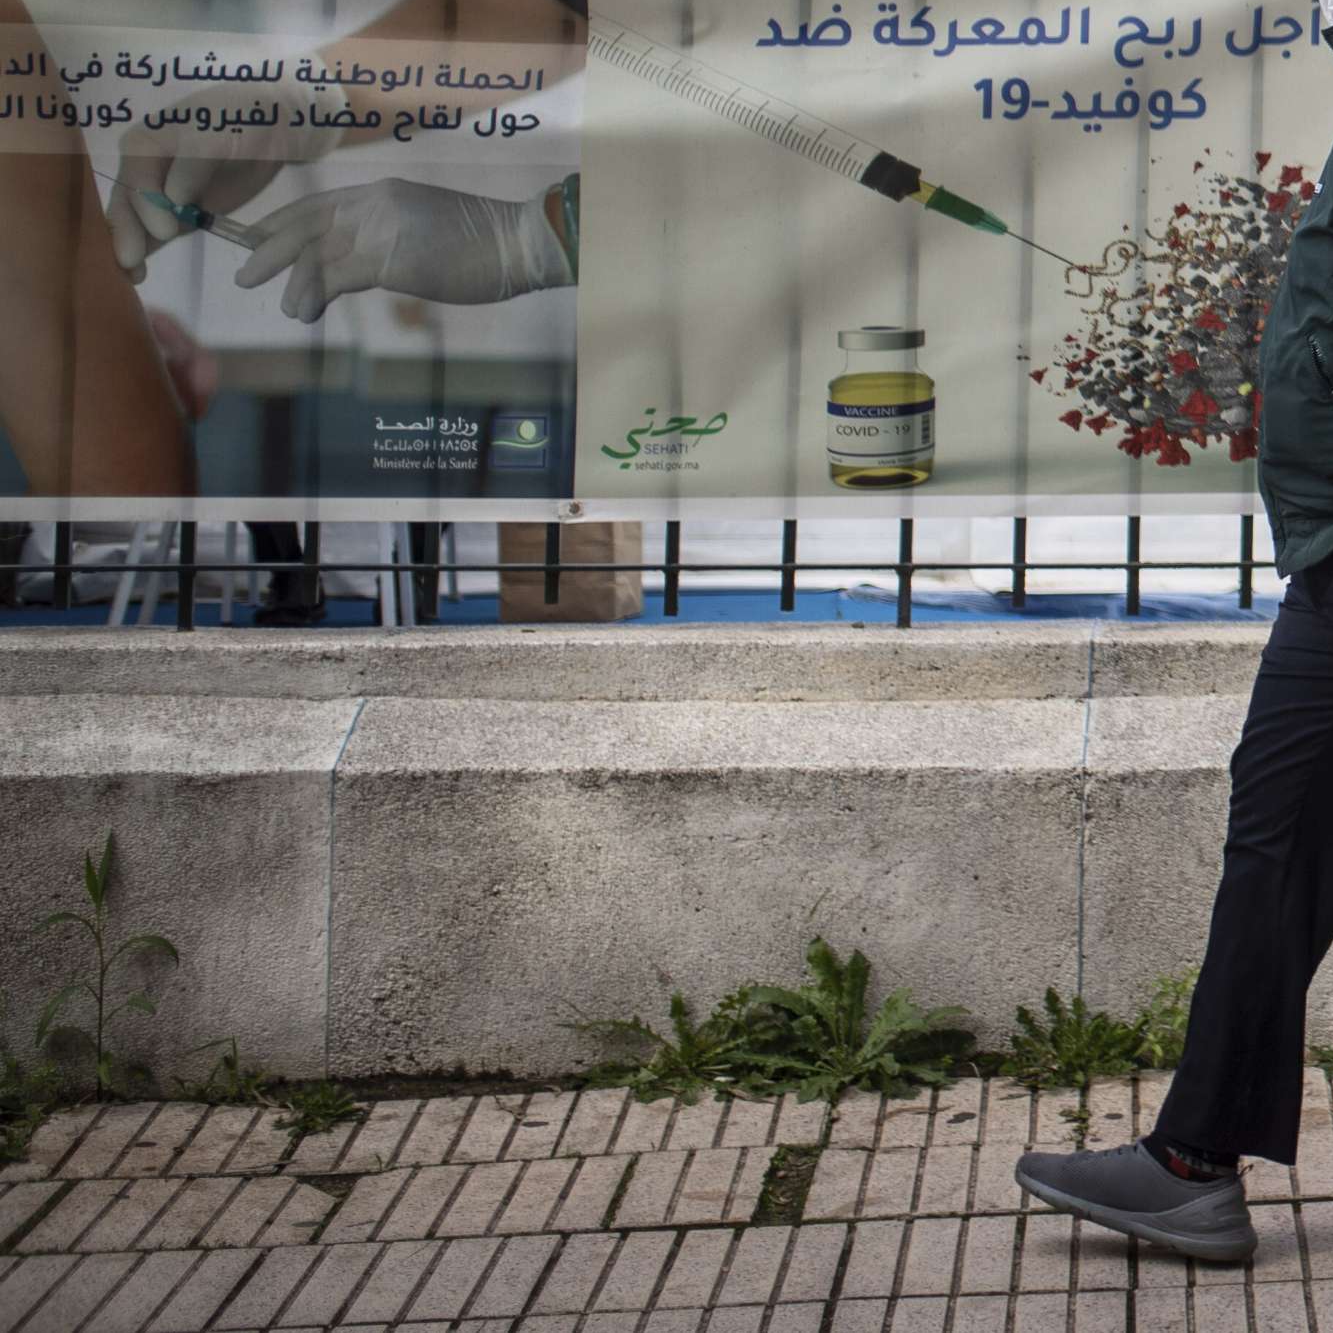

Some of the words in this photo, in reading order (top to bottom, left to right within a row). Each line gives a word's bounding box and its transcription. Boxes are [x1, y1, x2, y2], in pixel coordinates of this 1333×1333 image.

[755, 2, 852, 49] ضد
[872, 1, 1091, 57] المعركة
[1113, 11, 1201, 68] ربح
[59, 53, 103, 94] في
[115, 50, 284, 83] للمشاركة
[295, 58, 424, 93] الوطنية
[435, 67, 544, 92] الحملة
[37, 96, 133, 131] كورونا
[143, 101, 280, 134] لفيروس
[289, 101, 381, 131] مضاد
[973, 76, 1209, 134] كوفيد-19
[392, 107, 462, 143] لقاح
[473, 107, 541, 138] حول
[375, 416, 435, 431] الصحة
[439, 416, 479, 437] وزارة
[843, 405, 899, 418] VACCINE
[835, 425, 880, 438] COVID
[894, 424, 912, 437] 19
[372, 455, 421, 470] Ministère
[422, 454, 436, 470] de
[437, 454, 447, 470] la
[448, 456, 479, 470] Santé
[644, 442, 689, 456] SEHATI
[634, 460, 700, 473] sehati.gov.ma
